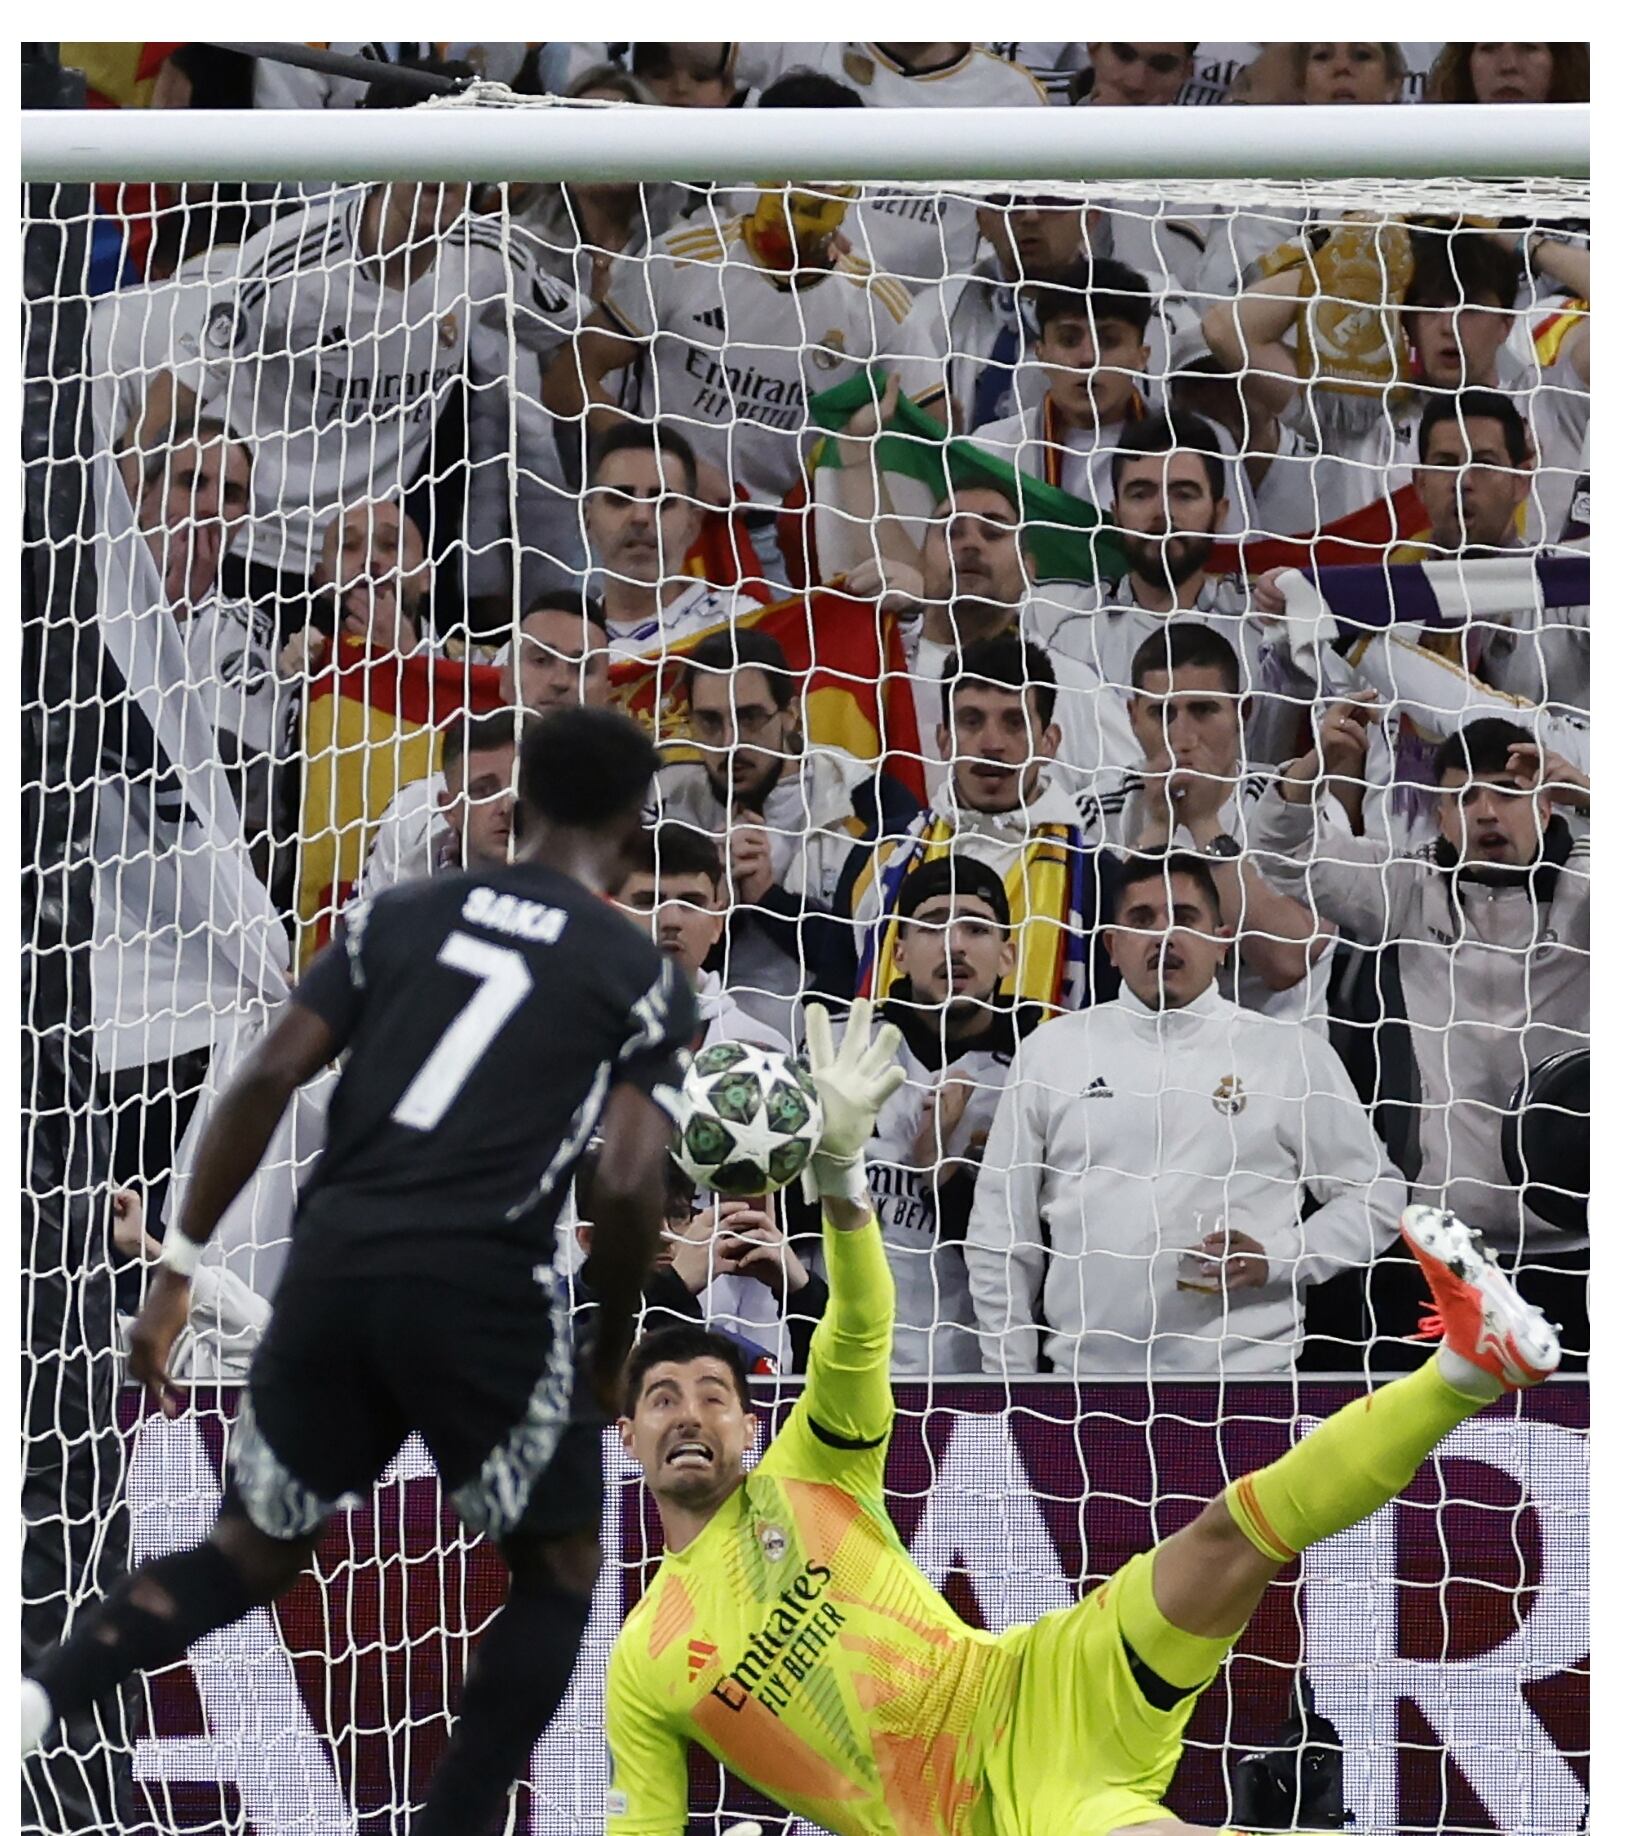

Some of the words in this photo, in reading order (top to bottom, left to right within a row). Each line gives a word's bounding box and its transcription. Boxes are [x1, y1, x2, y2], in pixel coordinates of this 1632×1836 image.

[693, 387, 729, 417] FLY
[461, 886, 568, 945] SAKA
[393, 931, 534, 1132] 7
[711, 1558, 831, 1712] Emirates
[757, 1672, 792, 1717] FLY
[780, 1601, 846, 1683] BETTER
